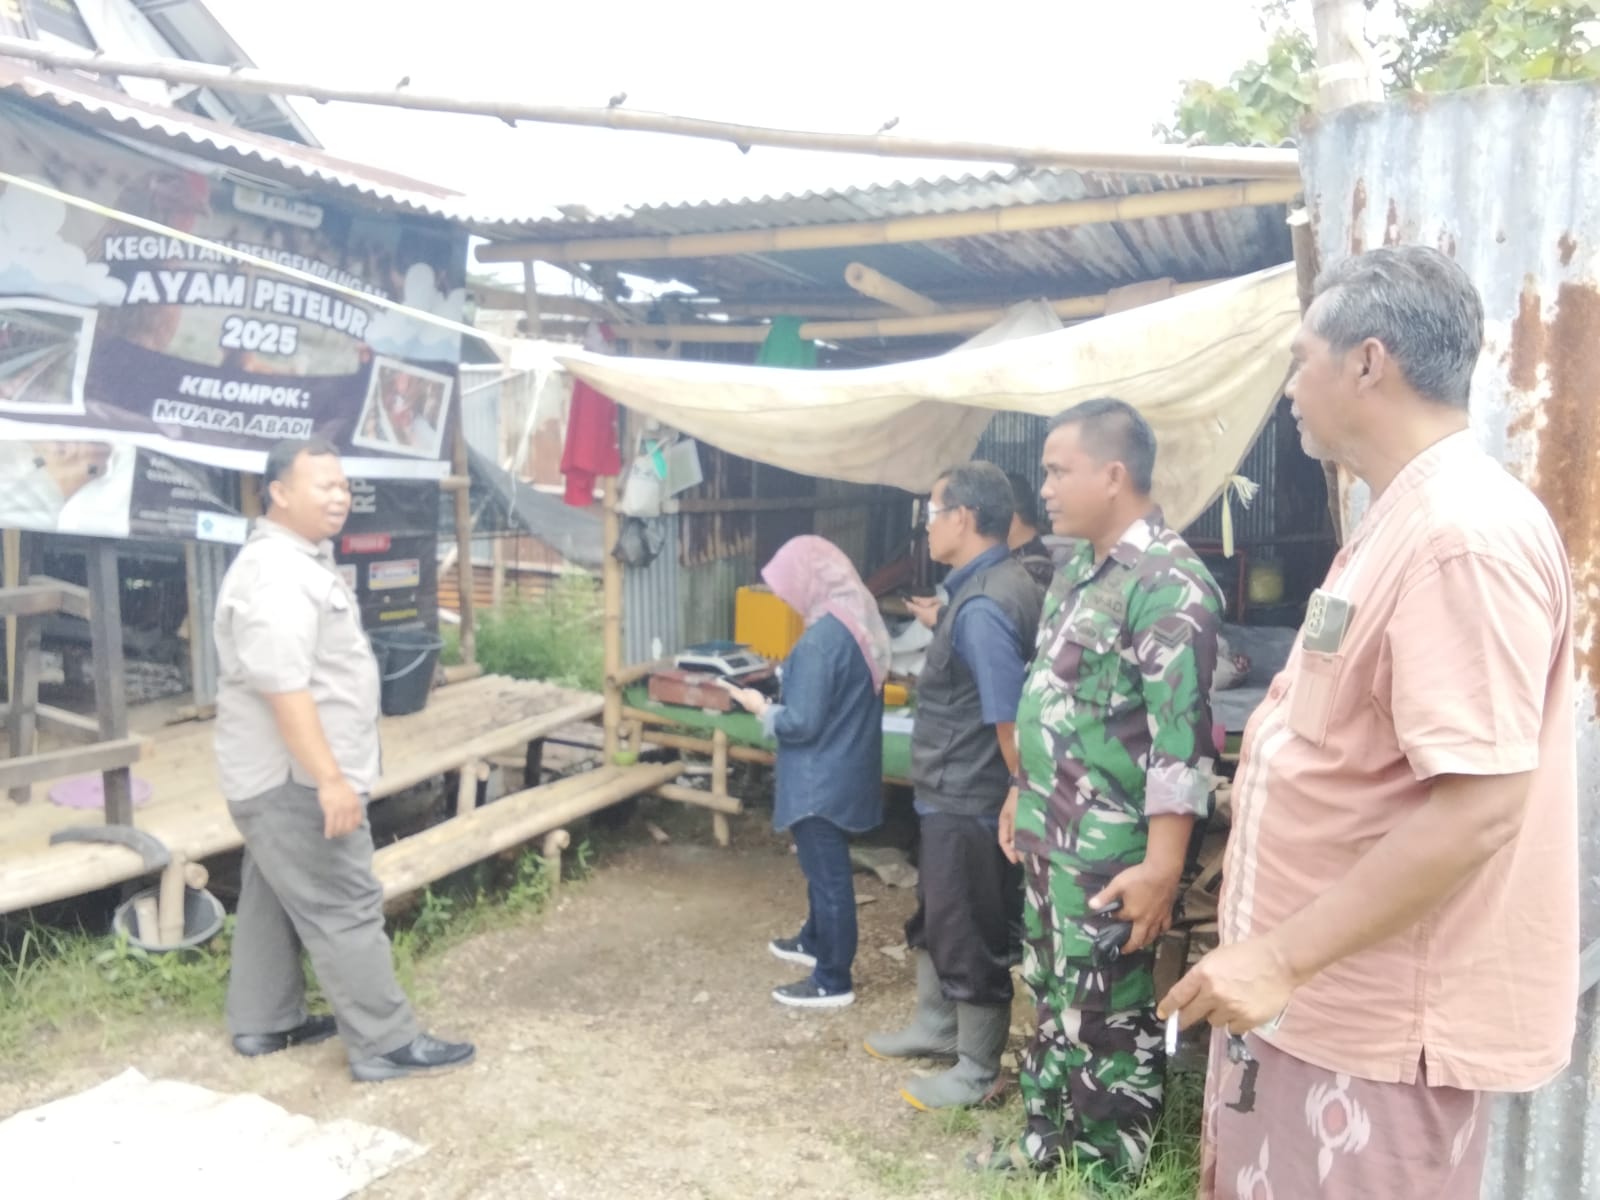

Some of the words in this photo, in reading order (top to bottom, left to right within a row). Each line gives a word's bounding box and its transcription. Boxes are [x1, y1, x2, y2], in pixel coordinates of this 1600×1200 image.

[127, 270, 246, 306] AYAM
[253, 278, 368, 338] PETELUR
[221, 316, 297, 354] 2025
[179, 375, 310, 409] KELOMPOK:
[153, 399, 244, 433] MUARA
[245, 415, 314, 440] ABADI
